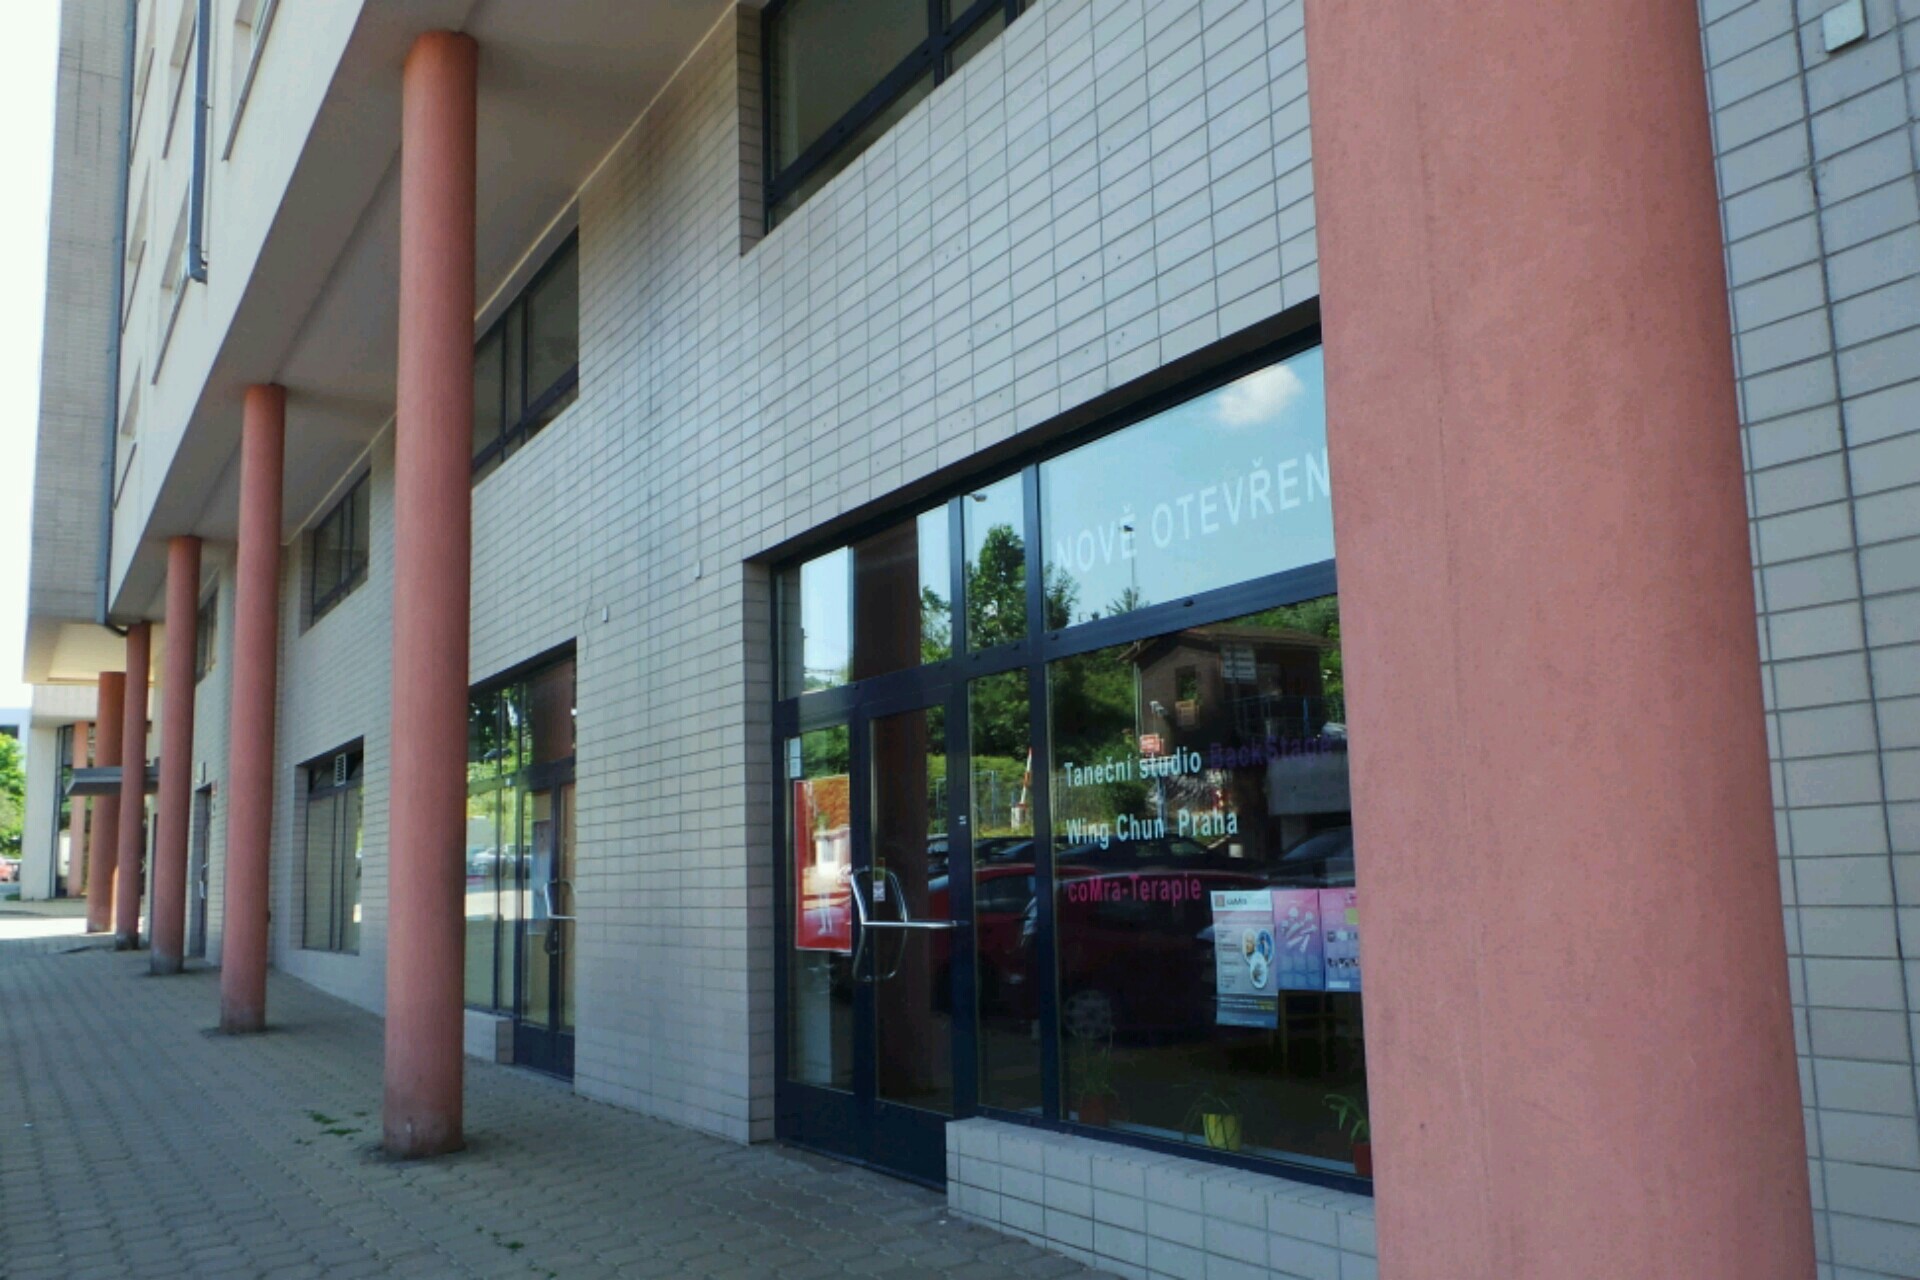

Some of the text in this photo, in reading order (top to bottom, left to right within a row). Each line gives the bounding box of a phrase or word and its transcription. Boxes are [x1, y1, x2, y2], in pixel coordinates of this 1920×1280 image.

[1055, 504, 1137, 572] NOVĚ
[1064, 756, 1132, 788] Taneční
[1139, 746, 1202, 779] studio
[1066, 808, 1238, 850] Wing Chun Praha
[1068, 873, 1202, 907] coMra-Terapie
